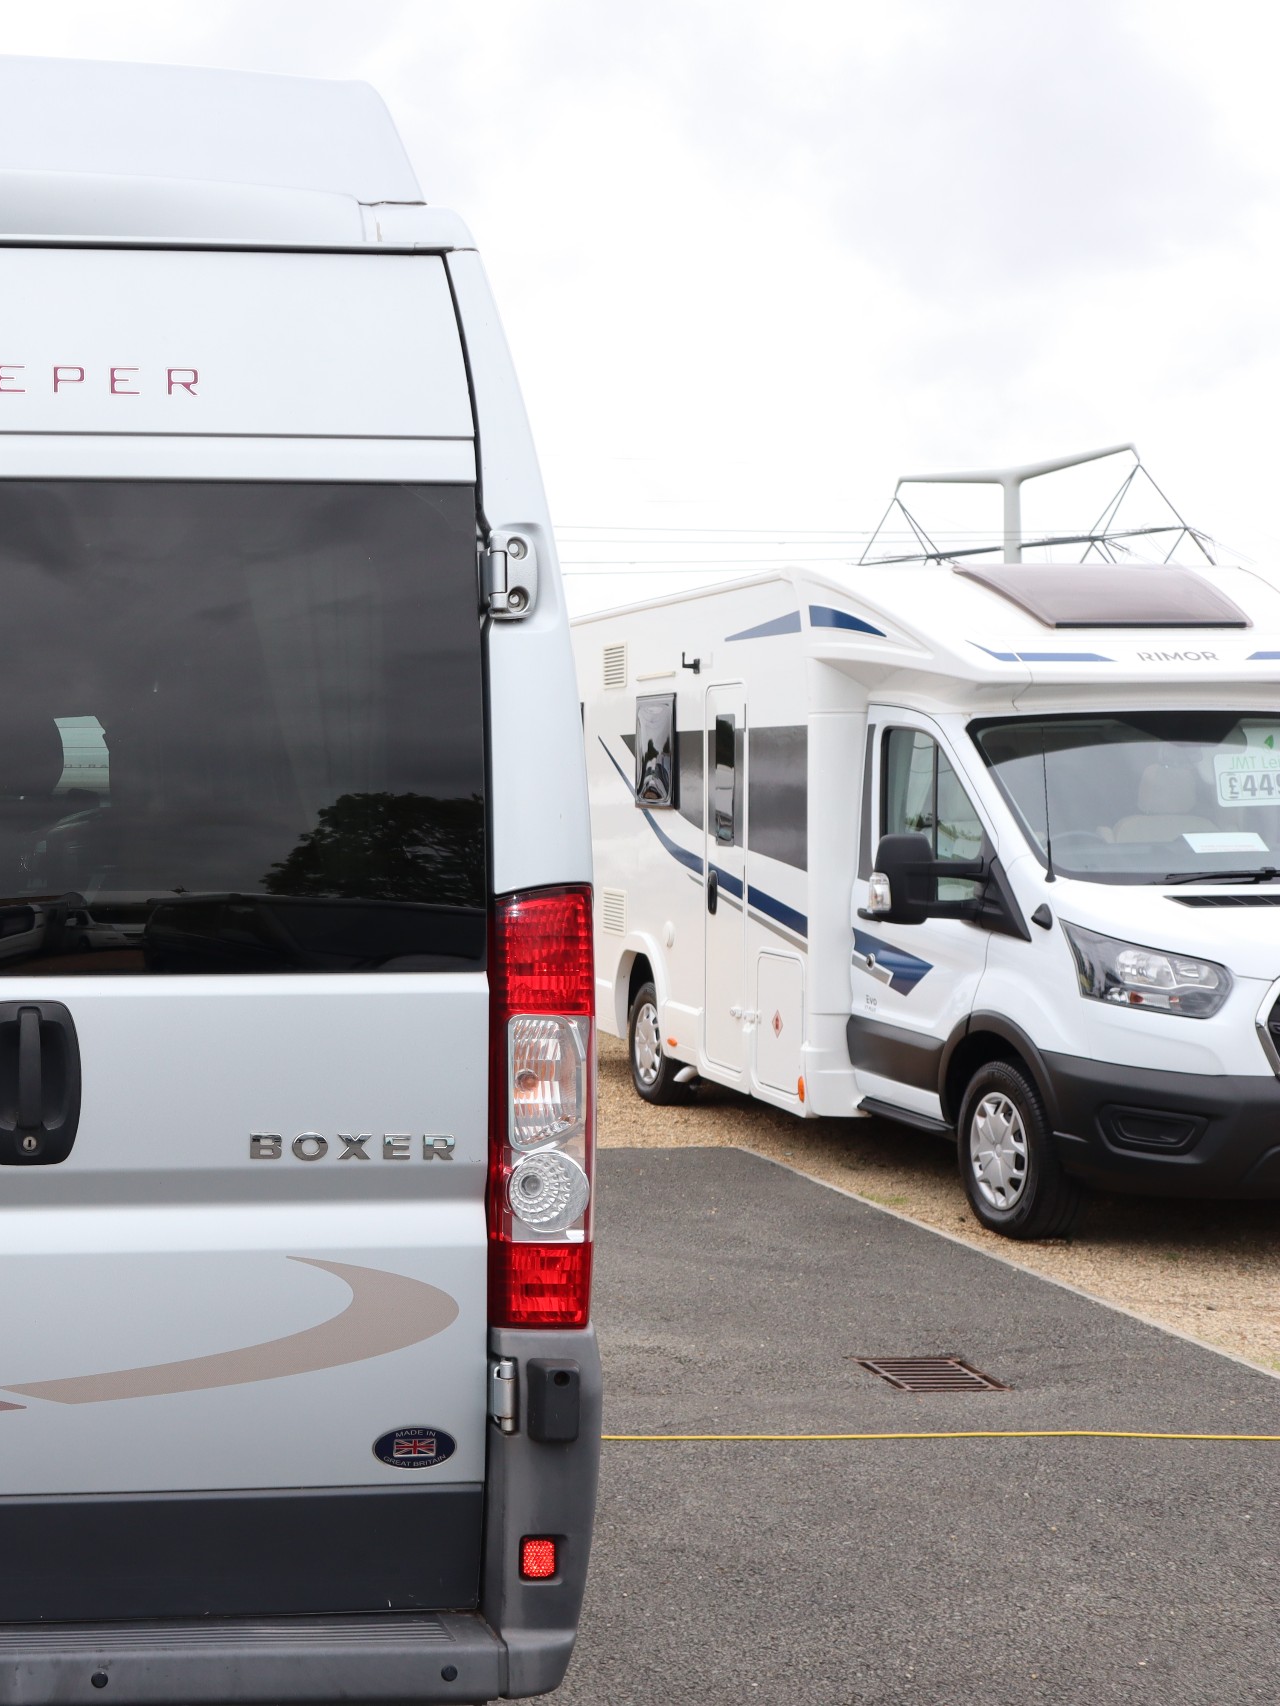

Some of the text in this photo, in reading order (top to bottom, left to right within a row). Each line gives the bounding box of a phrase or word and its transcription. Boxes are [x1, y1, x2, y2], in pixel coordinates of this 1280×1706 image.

[1136, 651, 1220, 661] RIMOR
[1229, 755, 1257, 770] JMT
[249, 1131, 456, 1161] BOXER
[395, 1429, 437, 1438] MADE IN
[383, 1454, 446, 1467] GREAT BRITAIN
